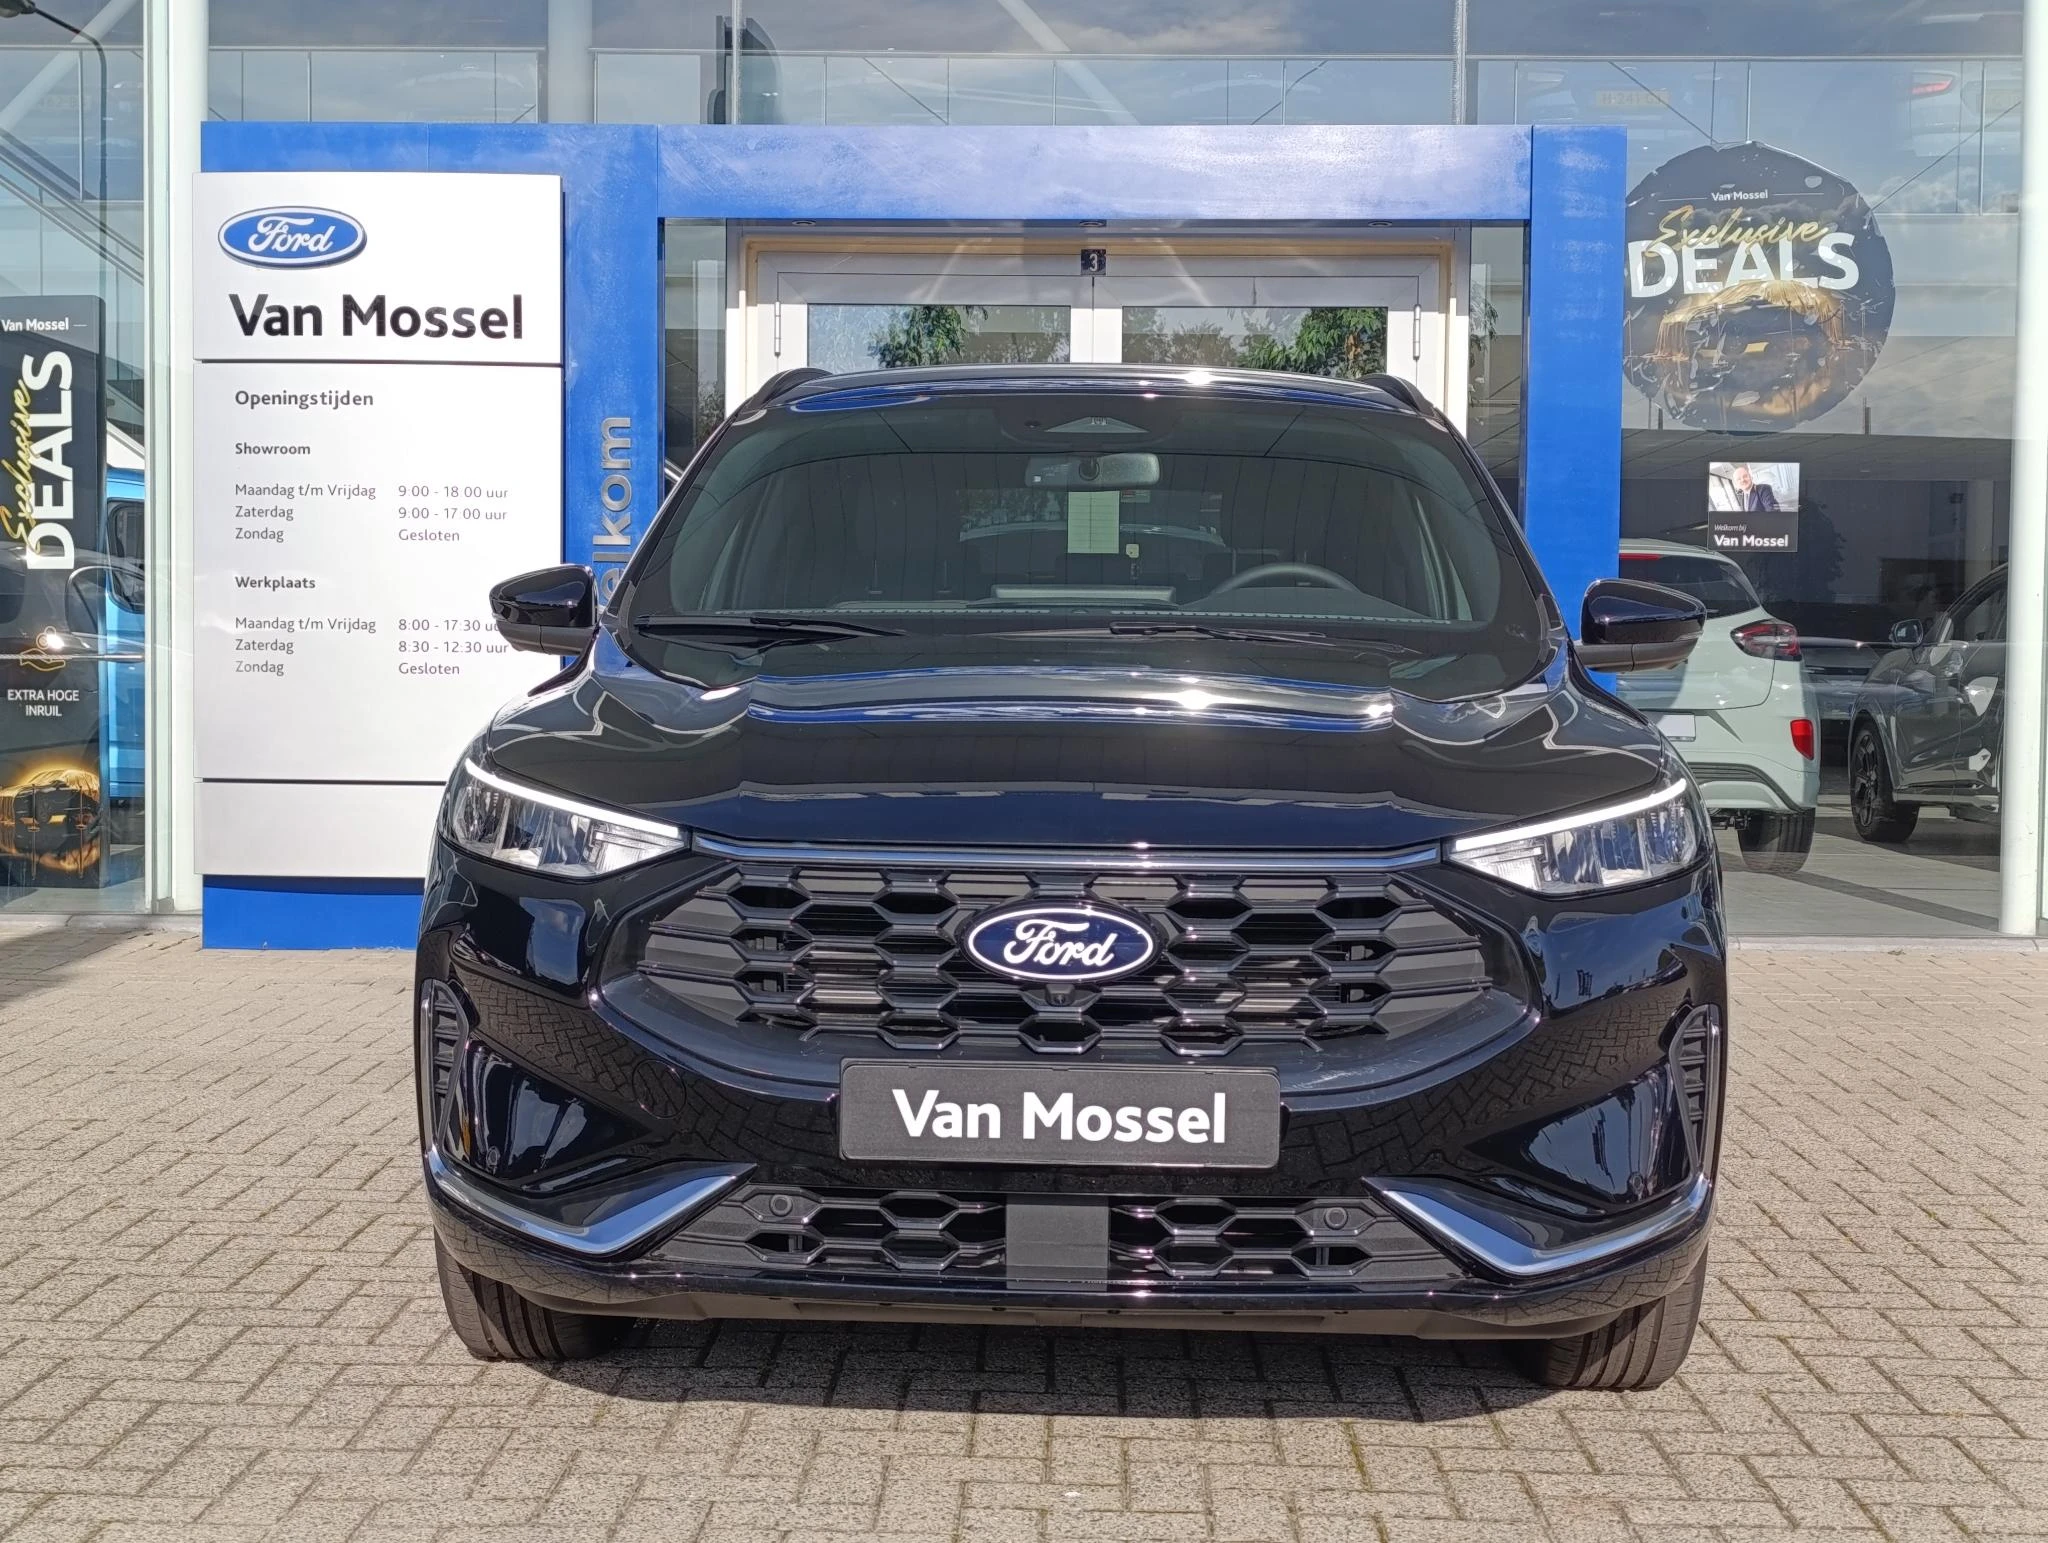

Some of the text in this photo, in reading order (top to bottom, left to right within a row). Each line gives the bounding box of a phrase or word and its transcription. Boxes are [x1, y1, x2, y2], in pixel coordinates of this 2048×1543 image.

[1711, 189, 1769, 201] Van Mossel
[247, 215, 336, 252] Ford
[1642, 205, 1830, 258] Exclusive
[1089, 253, 1098, 272] 3
[1628, 232, 1860, 298] DEALS
[1, 317, 69, 332] Van Mossel
[228, 293, 523, 340] Van Mossel
[234, 390, 374, 410] Openingstijden
[235, 442, 311, 455] Showroom
[22, 351, 75, 570] DEALS
[235, 483, 295, 499] Maandag
[298, 483, 323, 496] t/m
[327, 484, 376, 500] Vrijdag
[398, 485, 430, 497] 9:00
[486, 489, 508, 498] uur
[235, 505, 294, 521] Zaterdag
[398, 507, 430, 519] 9:00
[485, 511, 508, 520] uur
[235, 527, 460, 543] Zondag Gesloten
[1714, 523, 1738, 532] Welkom
[1713, 534, 1789, 547] Van Mossel
[235, 576, 316, 591] Werkplaats
[235, 617, 295, 633] Maandag
[298, 617, 323, 630] t/m
[327, 618, 376, 634] Vrijdag
[398, 618, 430, 631] 8:00
[443, 619, 481, 632] 17:30
[235, 638, 294, 654] Zaterdag
[398, 640, 430, 653] 8:30
[443, 641, 482, 653] 12:30
[486, 643, 509, 653] uur
[235, 660, 460, 676] Zondag Gesloten
[7, 689, 80, 701] EXTRA HOGE
[25, 705, 62, 717] INRUIL
[1003, 918, 1118, 966] Ford
[891, 1089, 1226, 1144] Van Mossel
